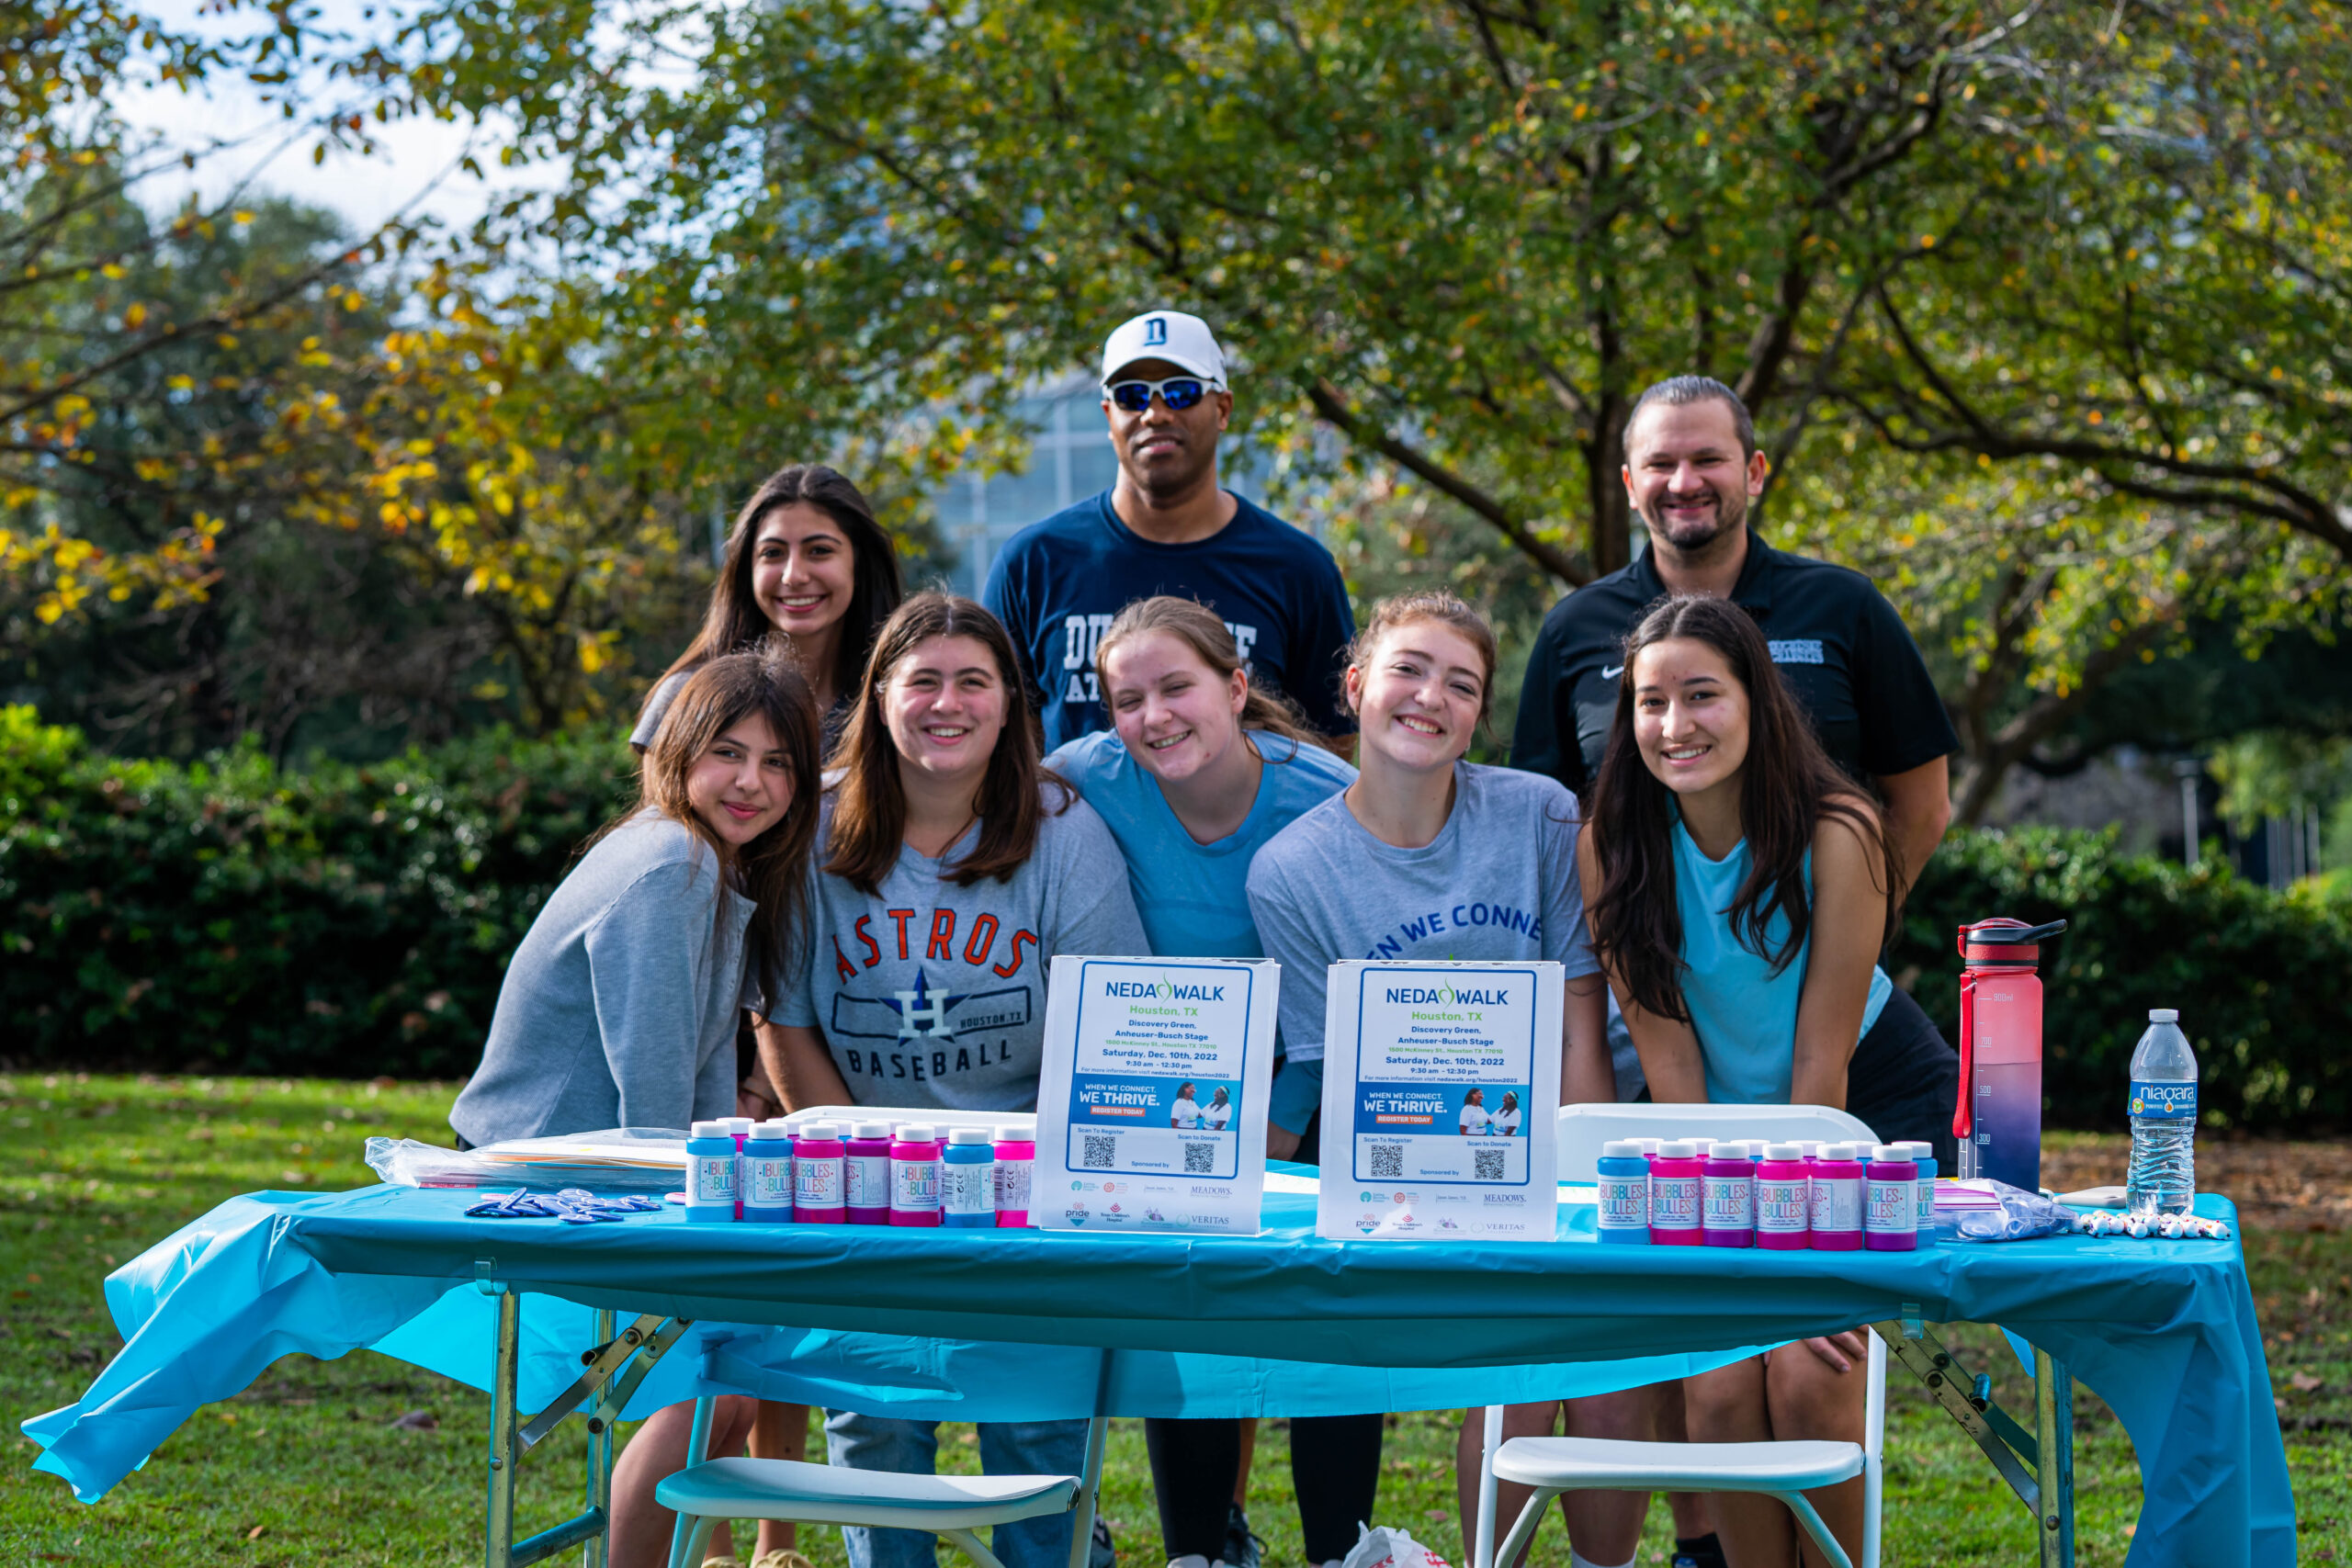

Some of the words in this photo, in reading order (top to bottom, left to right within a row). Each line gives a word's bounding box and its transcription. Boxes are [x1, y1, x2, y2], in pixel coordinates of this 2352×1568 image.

[1400, 912, 1445, 942] WE
[1452, 902, 1543, 942] CONNE
[832, 908, 1038, 985] ASTROS
[1106, 981, 1157, 998] NEDA
[1174, 984, 1225, 1000] WALK
[1386, 988, 1439, 1003] NEDA
[1456, 989, 1509, 1005] WALK
[1994, 993, 2013, 1001] 900ml
[895, 988, 952, 1037] H
[1010, 1011, 1022, 1021] TX
[1130, 1005, 1181, 1016] Houston,
[1184, 1007, 1198, 1016] TX
[1412, 1011, 1464, 1021] Houston,
[1467, 1011, 1483, 1021] TX
[1129, 1020, 1169, 1029] Discovery
[1115, 1030, 1182, 1039] Anheuser-Busch
[1185, 1032, 1208, 1041] Stage
[1981, 1036, 1992, 1045] 700
[1102, 1048, 1147, 1058] Saturday,
[847, 1039, 1012, 1081] BASEBALL
[1386, 1056, 1430, 1065] Saturday,
[1979, 1085, 1992, 1093] 500
[2141, 1084, 2194, 1102] niagara
[1080, 1090, 1101, 1102] WE
[1103, 1092, 1160, 1106] THRIVE.
[1363, 1100, 1385, 1111] WE
[1388, 1100, 1447, 1112] THRIVE.
[1979, 1134, 1991, 1142] 300
[1602, 1199, 1638, 1214] BULLES
[1656, 1199, 1691, 1214] BULLES
[1705, 1199, 1741, 1214] BULLES
[1765, 1202, 1801, 1218] BULLES
[1193, 1215, 1229, 1224] VERITAS
[1356, 1219, 1381, 1227] pride
